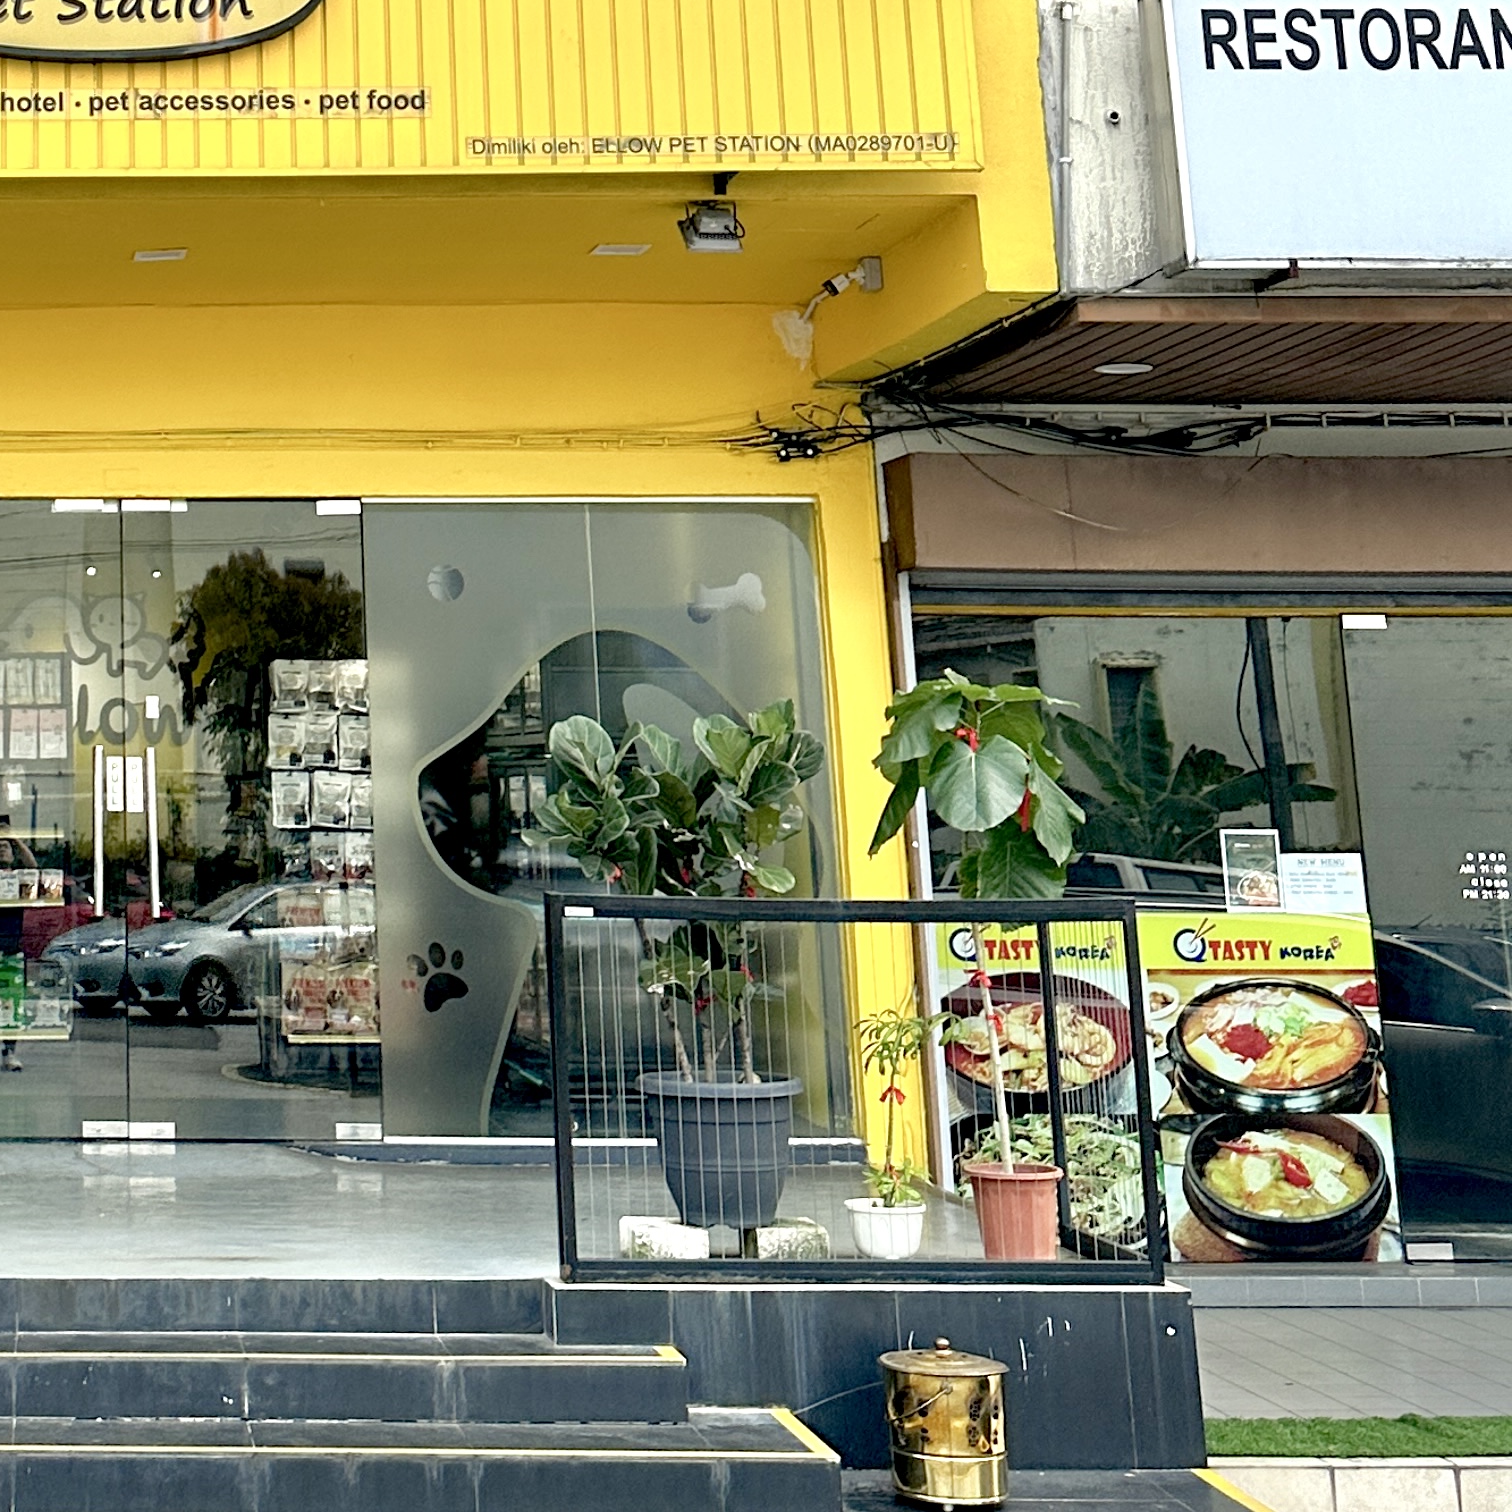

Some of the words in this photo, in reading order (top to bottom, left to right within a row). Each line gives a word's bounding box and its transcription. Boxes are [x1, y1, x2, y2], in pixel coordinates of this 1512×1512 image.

[0, 91, 64, 112] hotel
[89, 92, 129, 116] pet
[139, 90, 296, 111] accessories
[319, 90, 359, 115] pet
[367, 89, 426, 111] food
[471, 138, 536, 155] Dimiliki
[592, 137, 663, 154] ELLOW
[669, 137, 708, 153] PET
[714, 135, 800, 152] STATION
[984, 939, 1039, 960] TAST
[1055, 944, 1110, 961] KOREA
[1208, 939, 1273, 961] TASTY
[1280, 945, 1336, 961] KOREA
